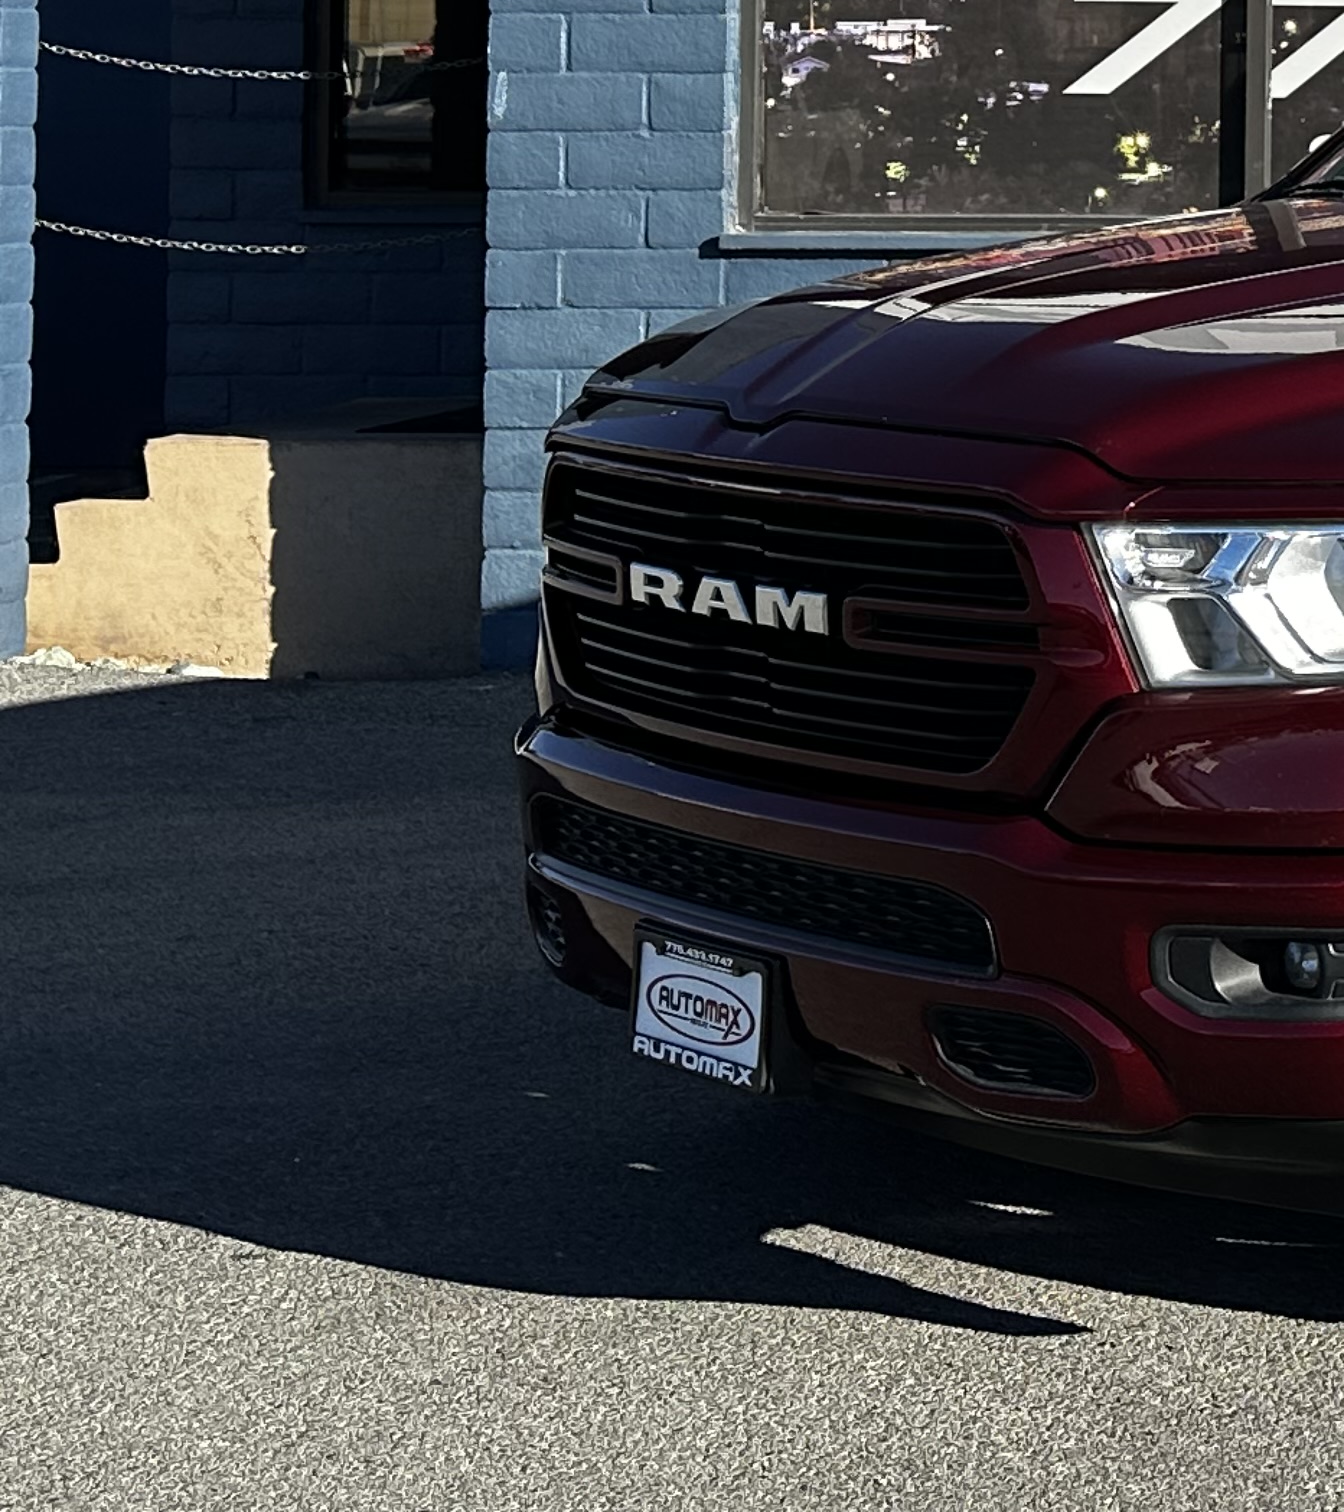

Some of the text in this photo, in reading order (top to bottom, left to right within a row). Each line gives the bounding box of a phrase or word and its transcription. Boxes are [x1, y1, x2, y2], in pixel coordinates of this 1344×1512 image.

[629, 562, 829, 636] RAM
[658, 984, 742, 1040] AUTOMAX
[632, 1035, 753, 1087] AUTOMAX
